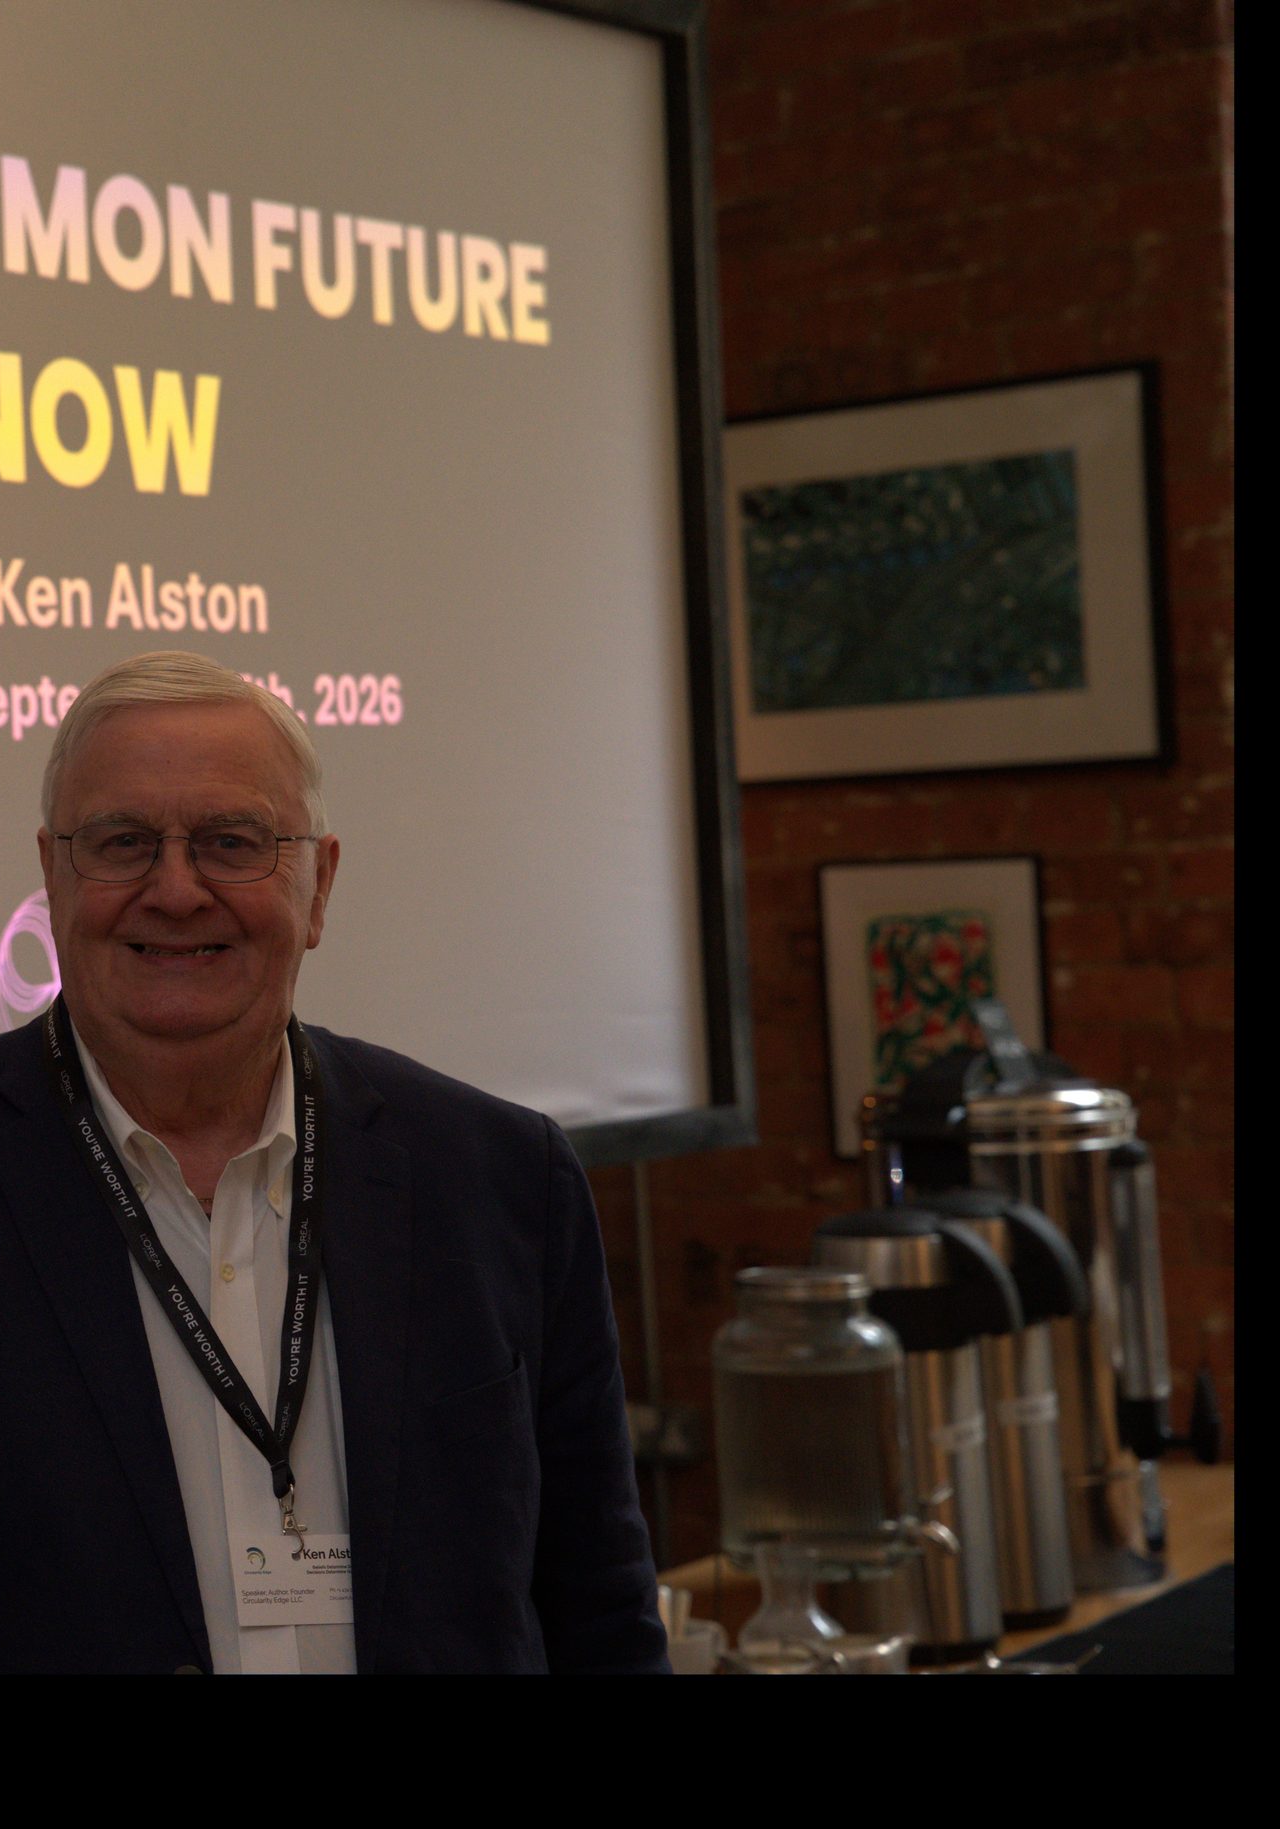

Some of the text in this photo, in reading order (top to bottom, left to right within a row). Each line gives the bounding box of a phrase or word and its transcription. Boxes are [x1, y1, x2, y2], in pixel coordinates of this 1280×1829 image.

[251, 199, 551, 346] FUTURE
[105, 562, 269, 633] Alston
[313, 672, 404, 726] 2026
[53, 1047, 62, 1059] IT
[78, 1117, 137, 1218] YOU'RE WORTH IT
[303, 1094, 316, 1202] YOU'RE WORTH IT
[167, 1284, 235, 1389] YOU'RE WORTH IT
[287, 1273, 309, 1386] YOU'RE WORTH IT
[303, 1547, 352, 1560] Ken Alst
[273, 1596, 290, 1605] Edge
